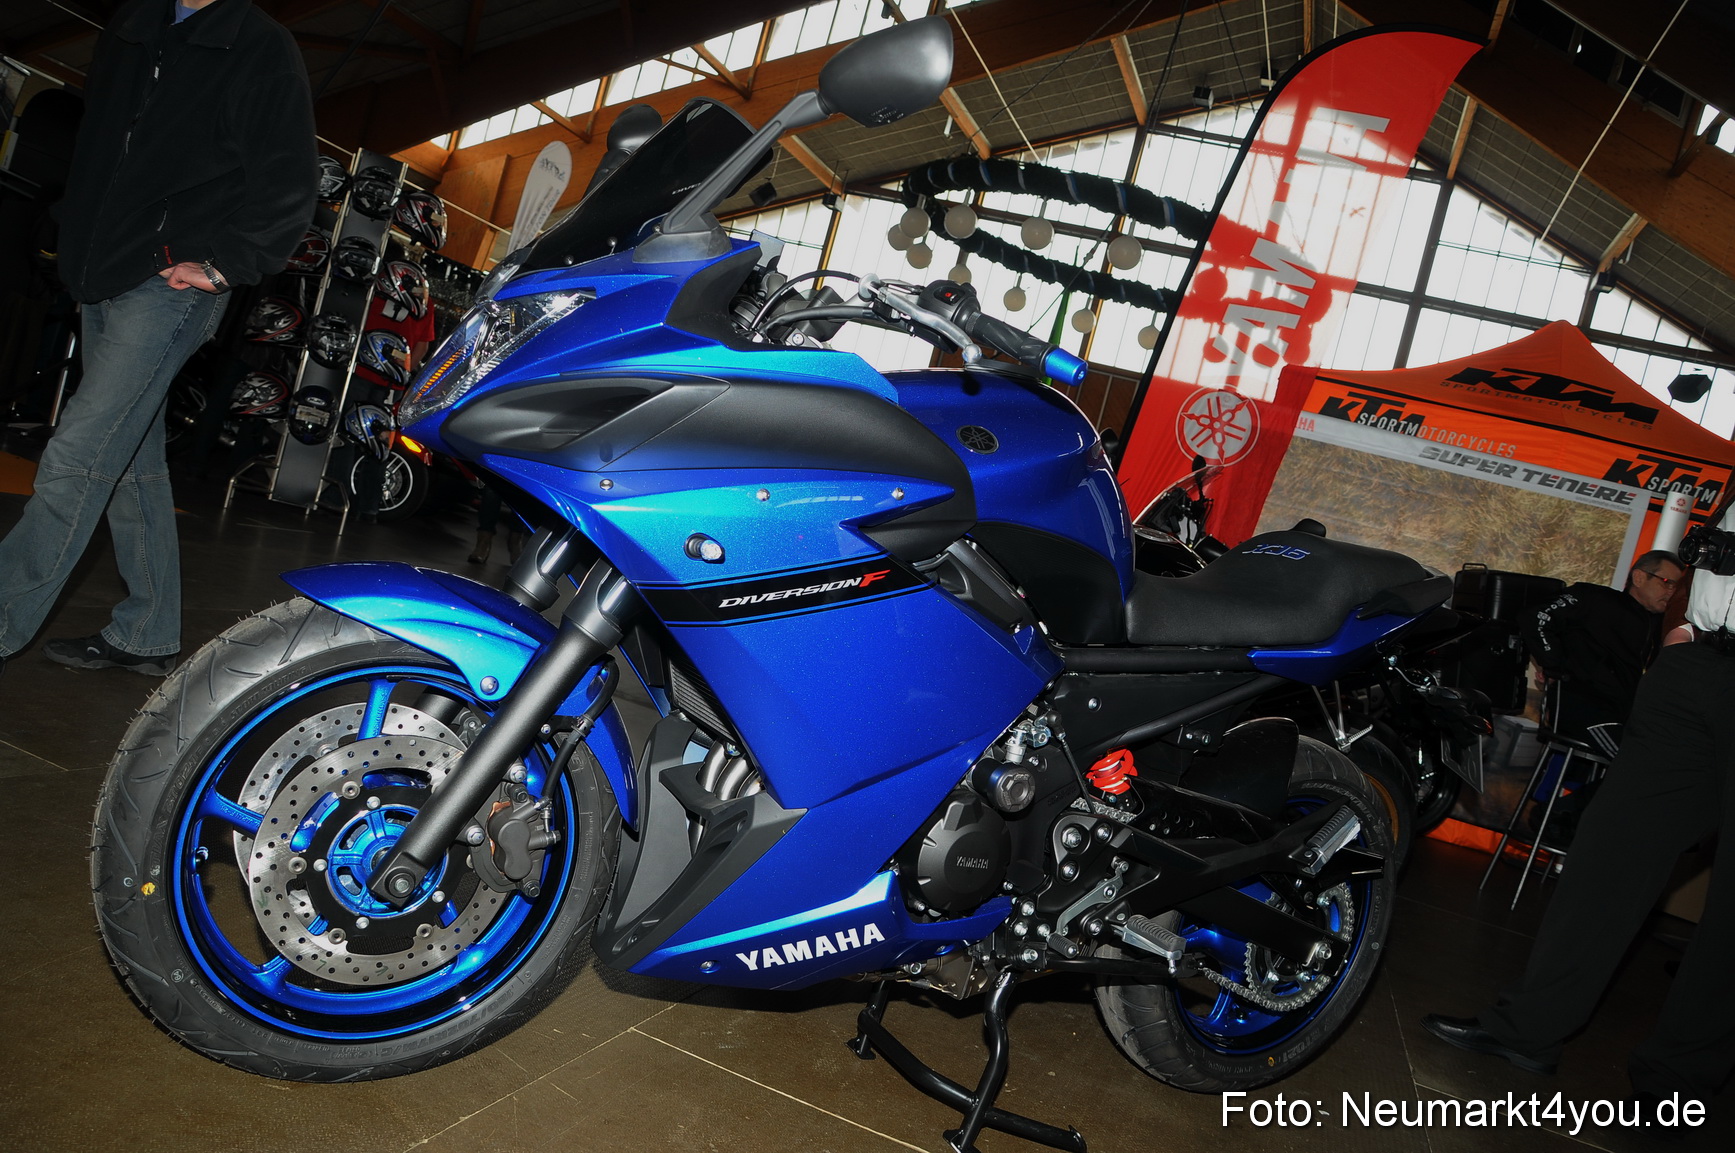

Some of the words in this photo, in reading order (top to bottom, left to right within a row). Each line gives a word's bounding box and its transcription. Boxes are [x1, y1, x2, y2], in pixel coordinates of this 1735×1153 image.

[1318, 391, 1425, 436] KTM
[1440, 381, 1653, 430] SPORTMOTORCYCLES
[1446, 367, 1659, 425] KTM
[1357, 412, 1517, 458] SPORTMOTORCYCLES
[1418, 445, 1518, 479] SUPER
[1602, 453, 1725, 512] KTM
[956, 855, 990, 870] YAMAHA
[735, 922, 886, 973] YAMAHA
